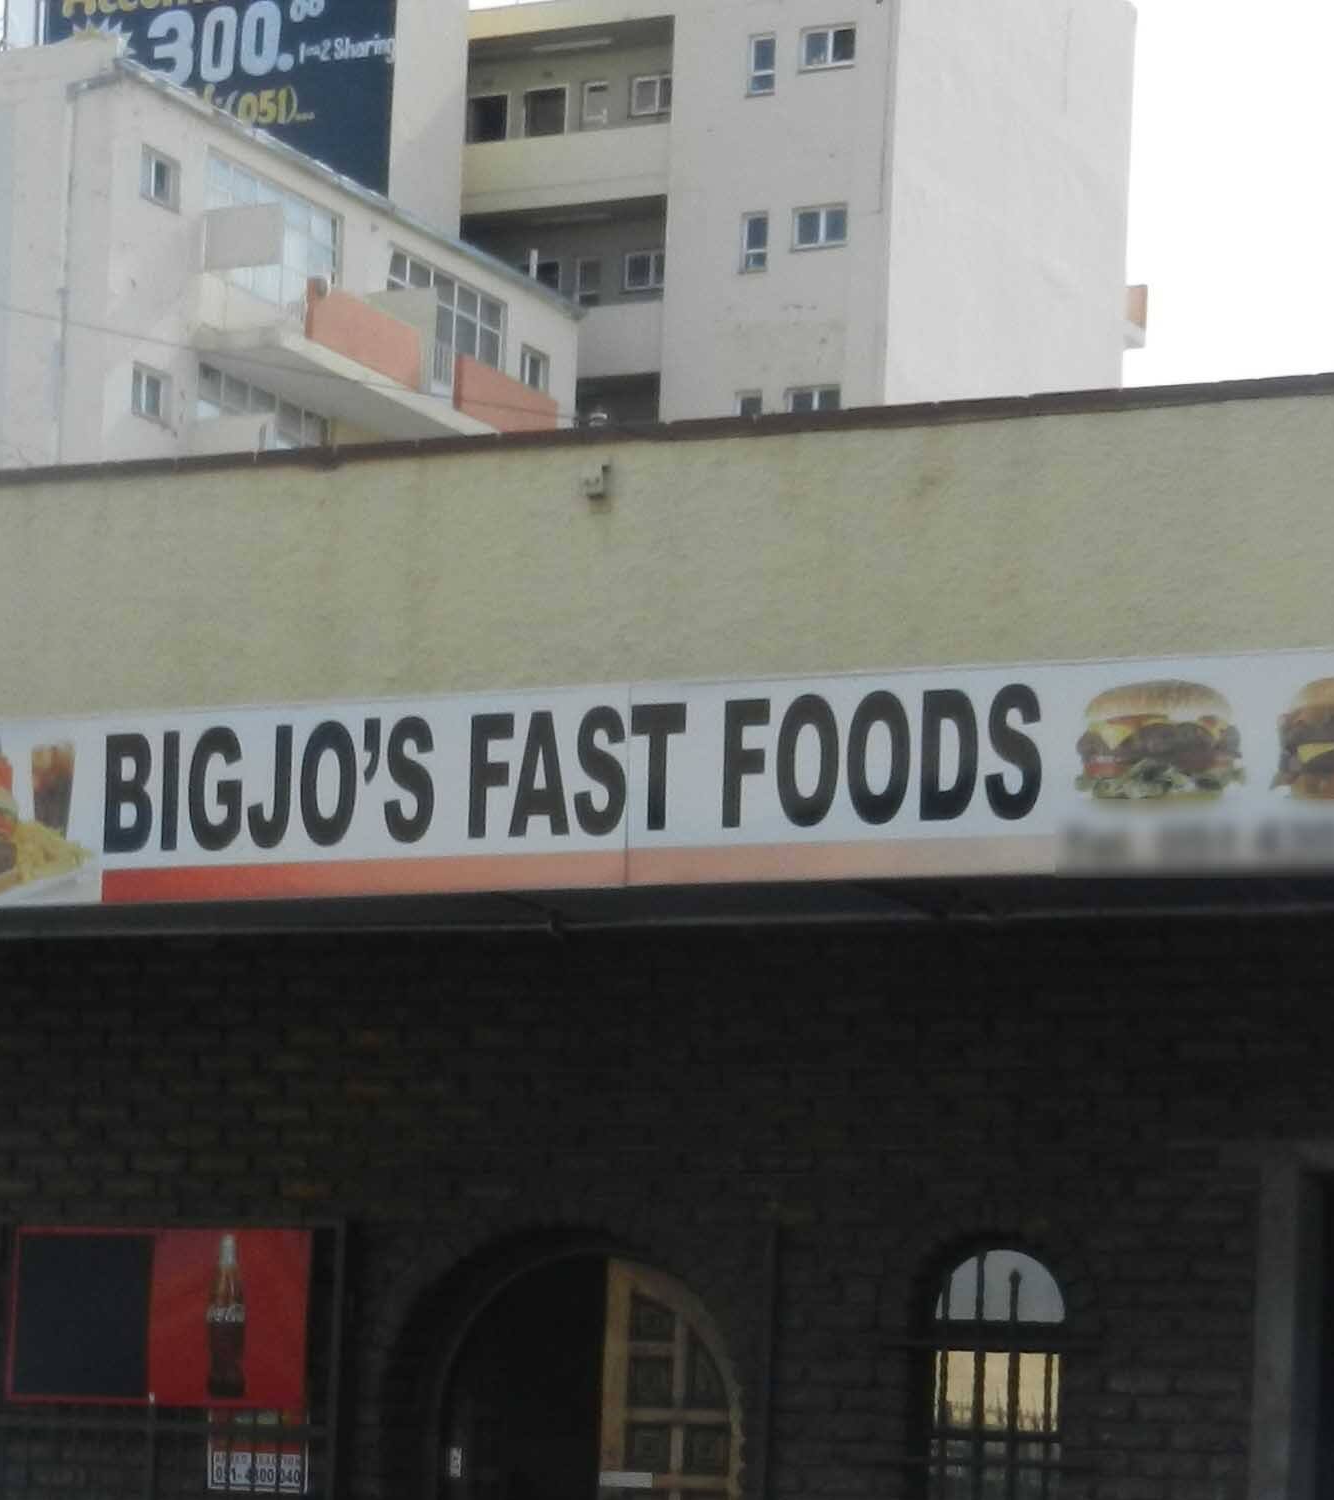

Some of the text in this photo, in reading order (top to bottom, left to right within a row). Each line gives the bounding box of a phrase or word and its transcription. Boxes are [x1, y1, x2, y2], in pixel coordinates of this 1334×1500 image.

[103, 682, 1043, 853] BIGJO'S FAST FOODS
